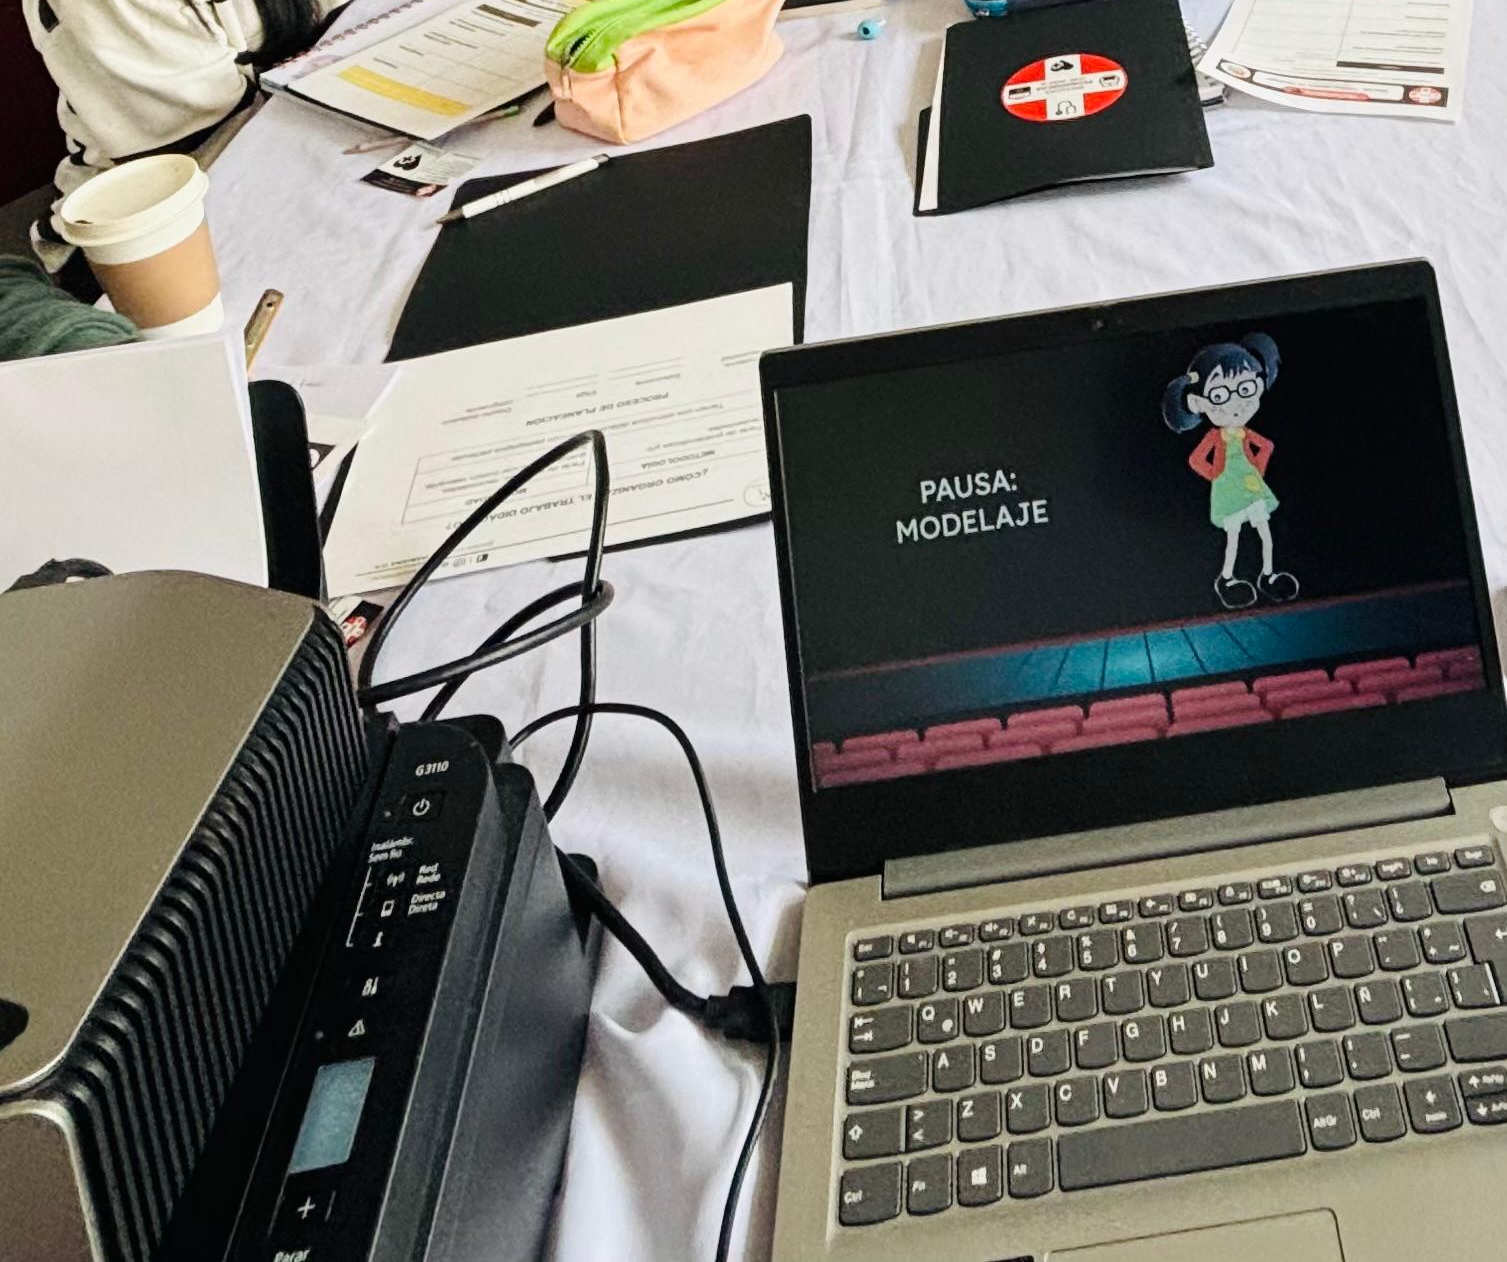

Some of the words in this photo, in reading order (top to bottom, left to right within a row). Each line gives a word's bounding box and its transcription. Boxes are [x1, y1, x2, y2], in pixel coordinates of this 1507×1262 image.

[920, 469, 1018, 504] PAUSA:
[520, 496, 574, 515] TRABAJO
[895, 498, 1050, 544] MODELAJE
[415, 759, 449, 777] G3110
[411, 890, 446, 904] Directa
[408, 901, 439, 916] Direta
[1261, 923, 1272, 937] 9
[1306, 915, 1316, 929] 0
[1172, 937, 1182, 951] 7
[1332, 941, 1345, 957] P
[1241, 956, 1249, 972] I
[1287, 948, 1301, 964] O
[948, 971, 957, 985] 2
[992, 964, 1002, 979] 3
[1151, 971, 1162, 986] Y
[1195, 963, 1208, 978] U
[1059, 984, 1072, 1001] R
[1104, 977, 1117, 993] T
[967, 997, 985, 1014] W
[1013, 991, 1026, 1007] E
[1312, 994, 1324, 1010] L
[922, 1005, 936, 1022] Q
[1219, 1007, 1230, 1026] J
[1265, 1001, 1279, 1018] K
[1125, 1022, 1140, 1038] G
[1171, 1015, 1186, 1033] H
[1031, 1037, 1044, 1053] D
[1078, 1029, 1089, 1046] F
[937, 1052, 950, 1069] A
[984, 1044, 997, 1062] S
[1202, 1061, 1218, 1080] N
[1250, 1054, 1267, 1073] M
[1107, 1077, 1120, 1095] V
[1155, 1069, 1168, 1087] B
[1009, 1092, 1023, 1110] X
[1059, 1084, 1073, 1102] C
[961, 1100, 974, 1118] Z
[1361, 1107, 1381, 1121] Ctrl
[1313, 1114, 1338, 1129] AltGr
[1012, 1163, 1028, 1176] Alt
[843, 1190, 863, 1204] Ctrl
